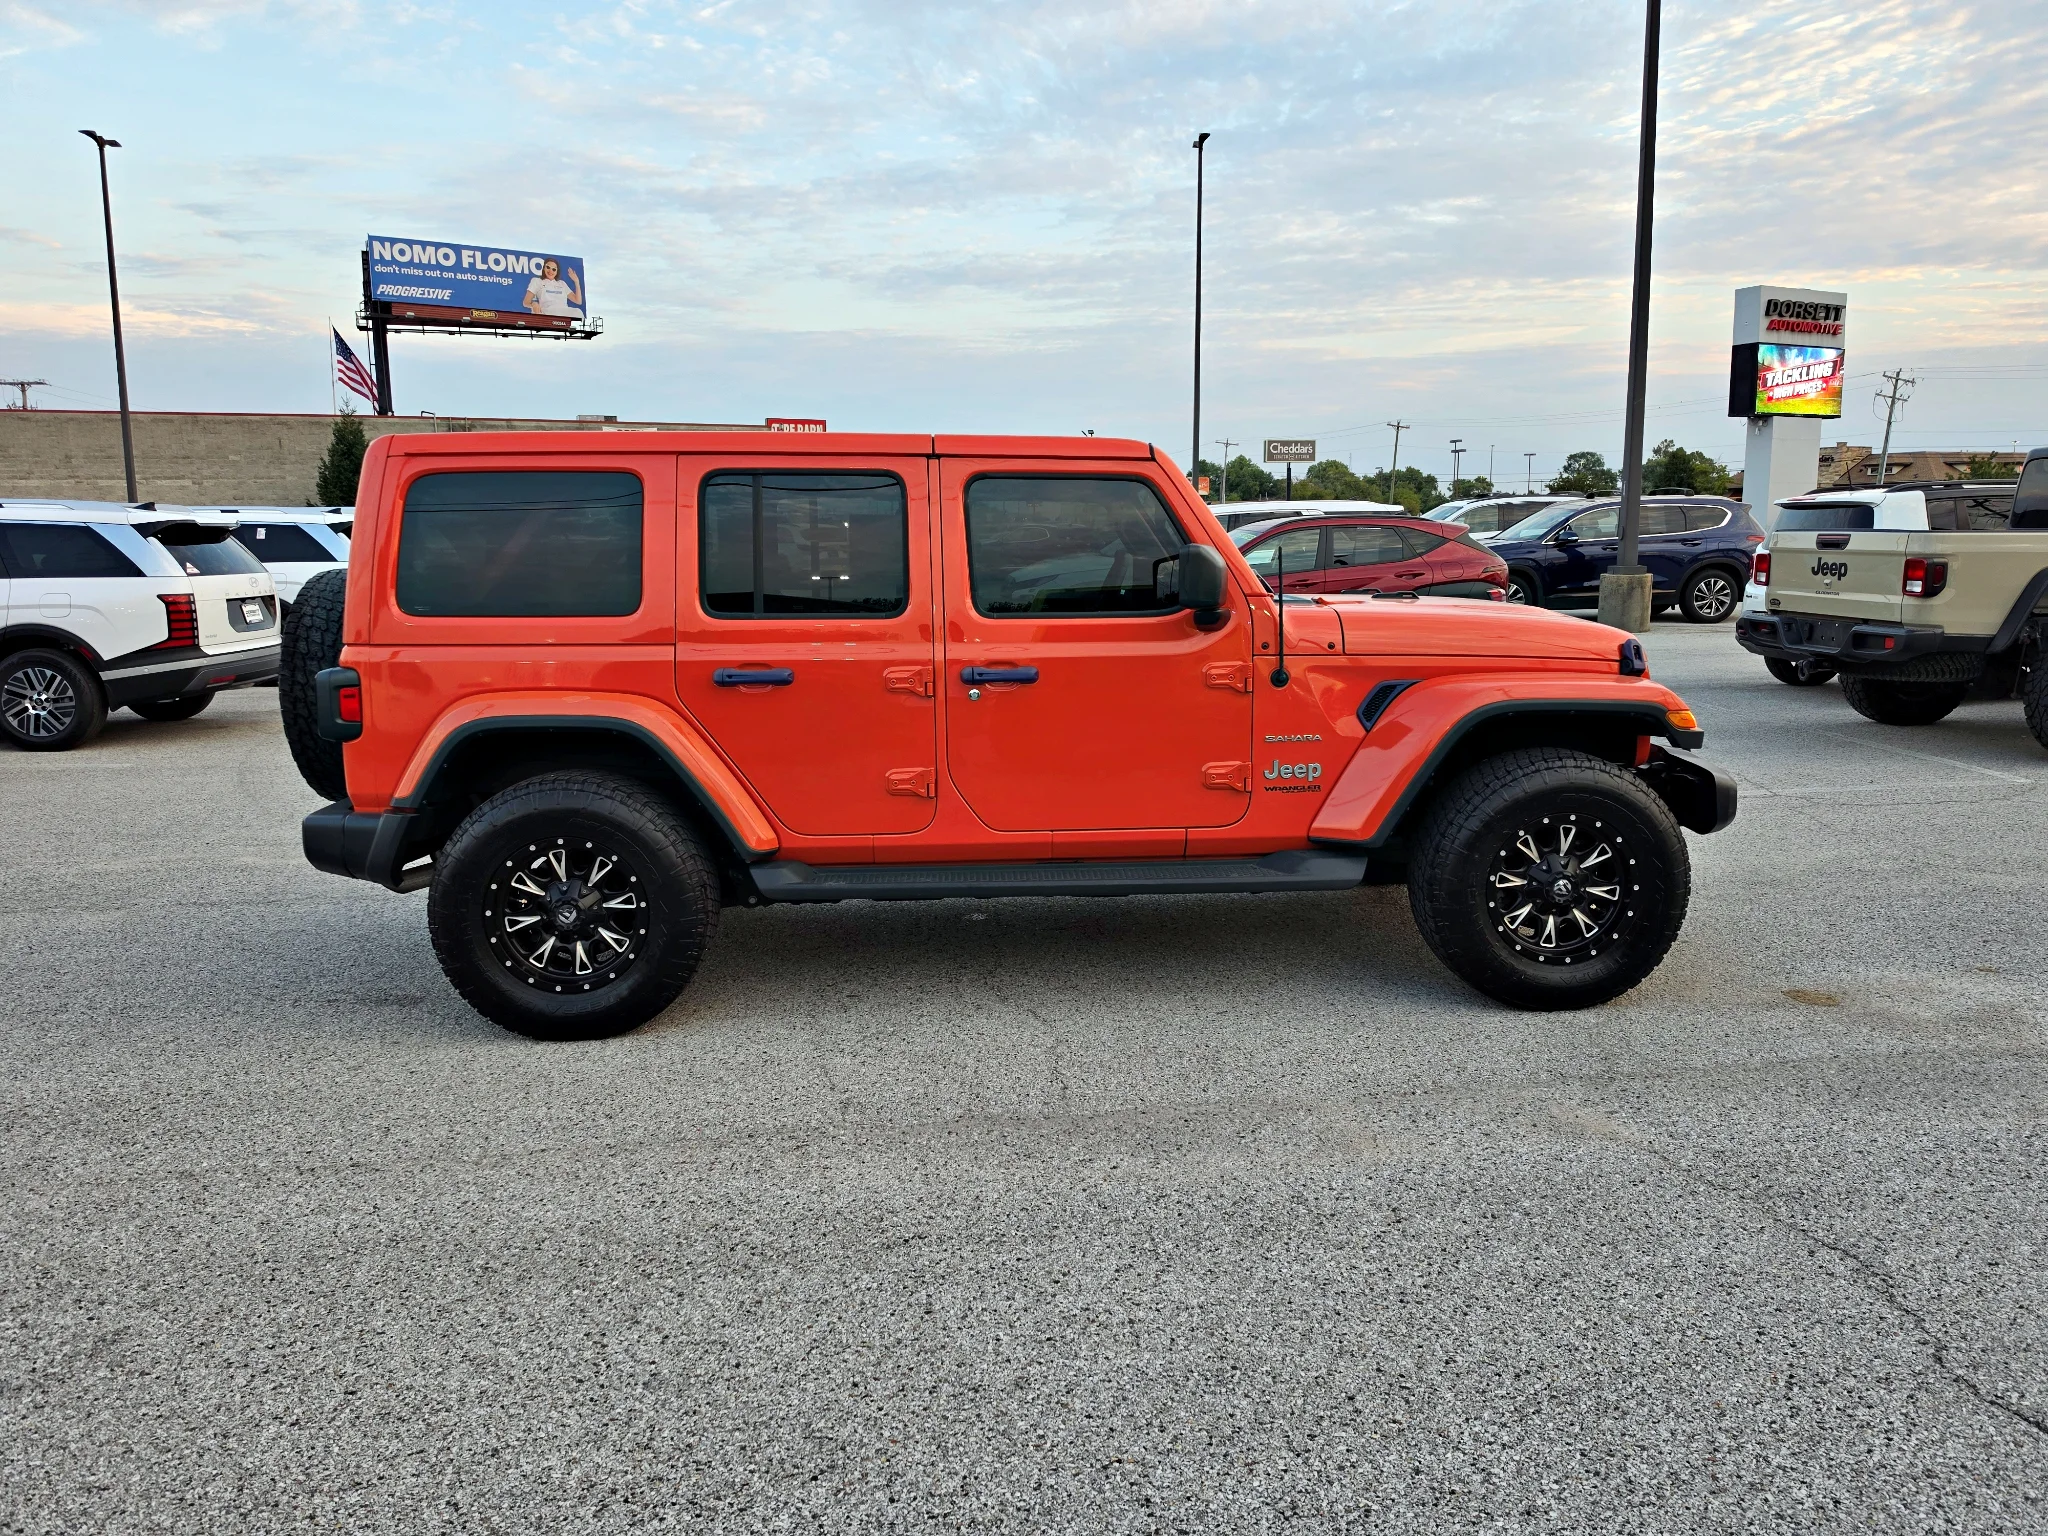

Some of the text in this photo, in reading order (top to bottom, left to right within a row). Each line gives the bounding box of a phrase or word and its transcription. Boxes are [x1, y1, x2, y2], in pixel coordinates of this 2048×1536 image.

[372, 241, 545, 276] NOMO FLOMO
[374, 263, 400, 274] don't
[401, 267, 424, 276] miss
[425, 270, 441, 278] out
[456, 272, 478, 281] auto
[478, 275, 513, 286] savings
[376, 284, 452, 300] PROGRESSIVE
[1765, 299, 1846, 321] DORSETT
[1766, 319, 1844, 335] AUTOMOTIVE
[1765, 362, 1834, 387] TACKLING
[1269, 443, 1313, 453] Cheddar's
[1811, 557, 1848, 581] Jeep
[1264, 734, 1322, 742] SAHARA
[1263, 759, 1322, 782] Jeep
